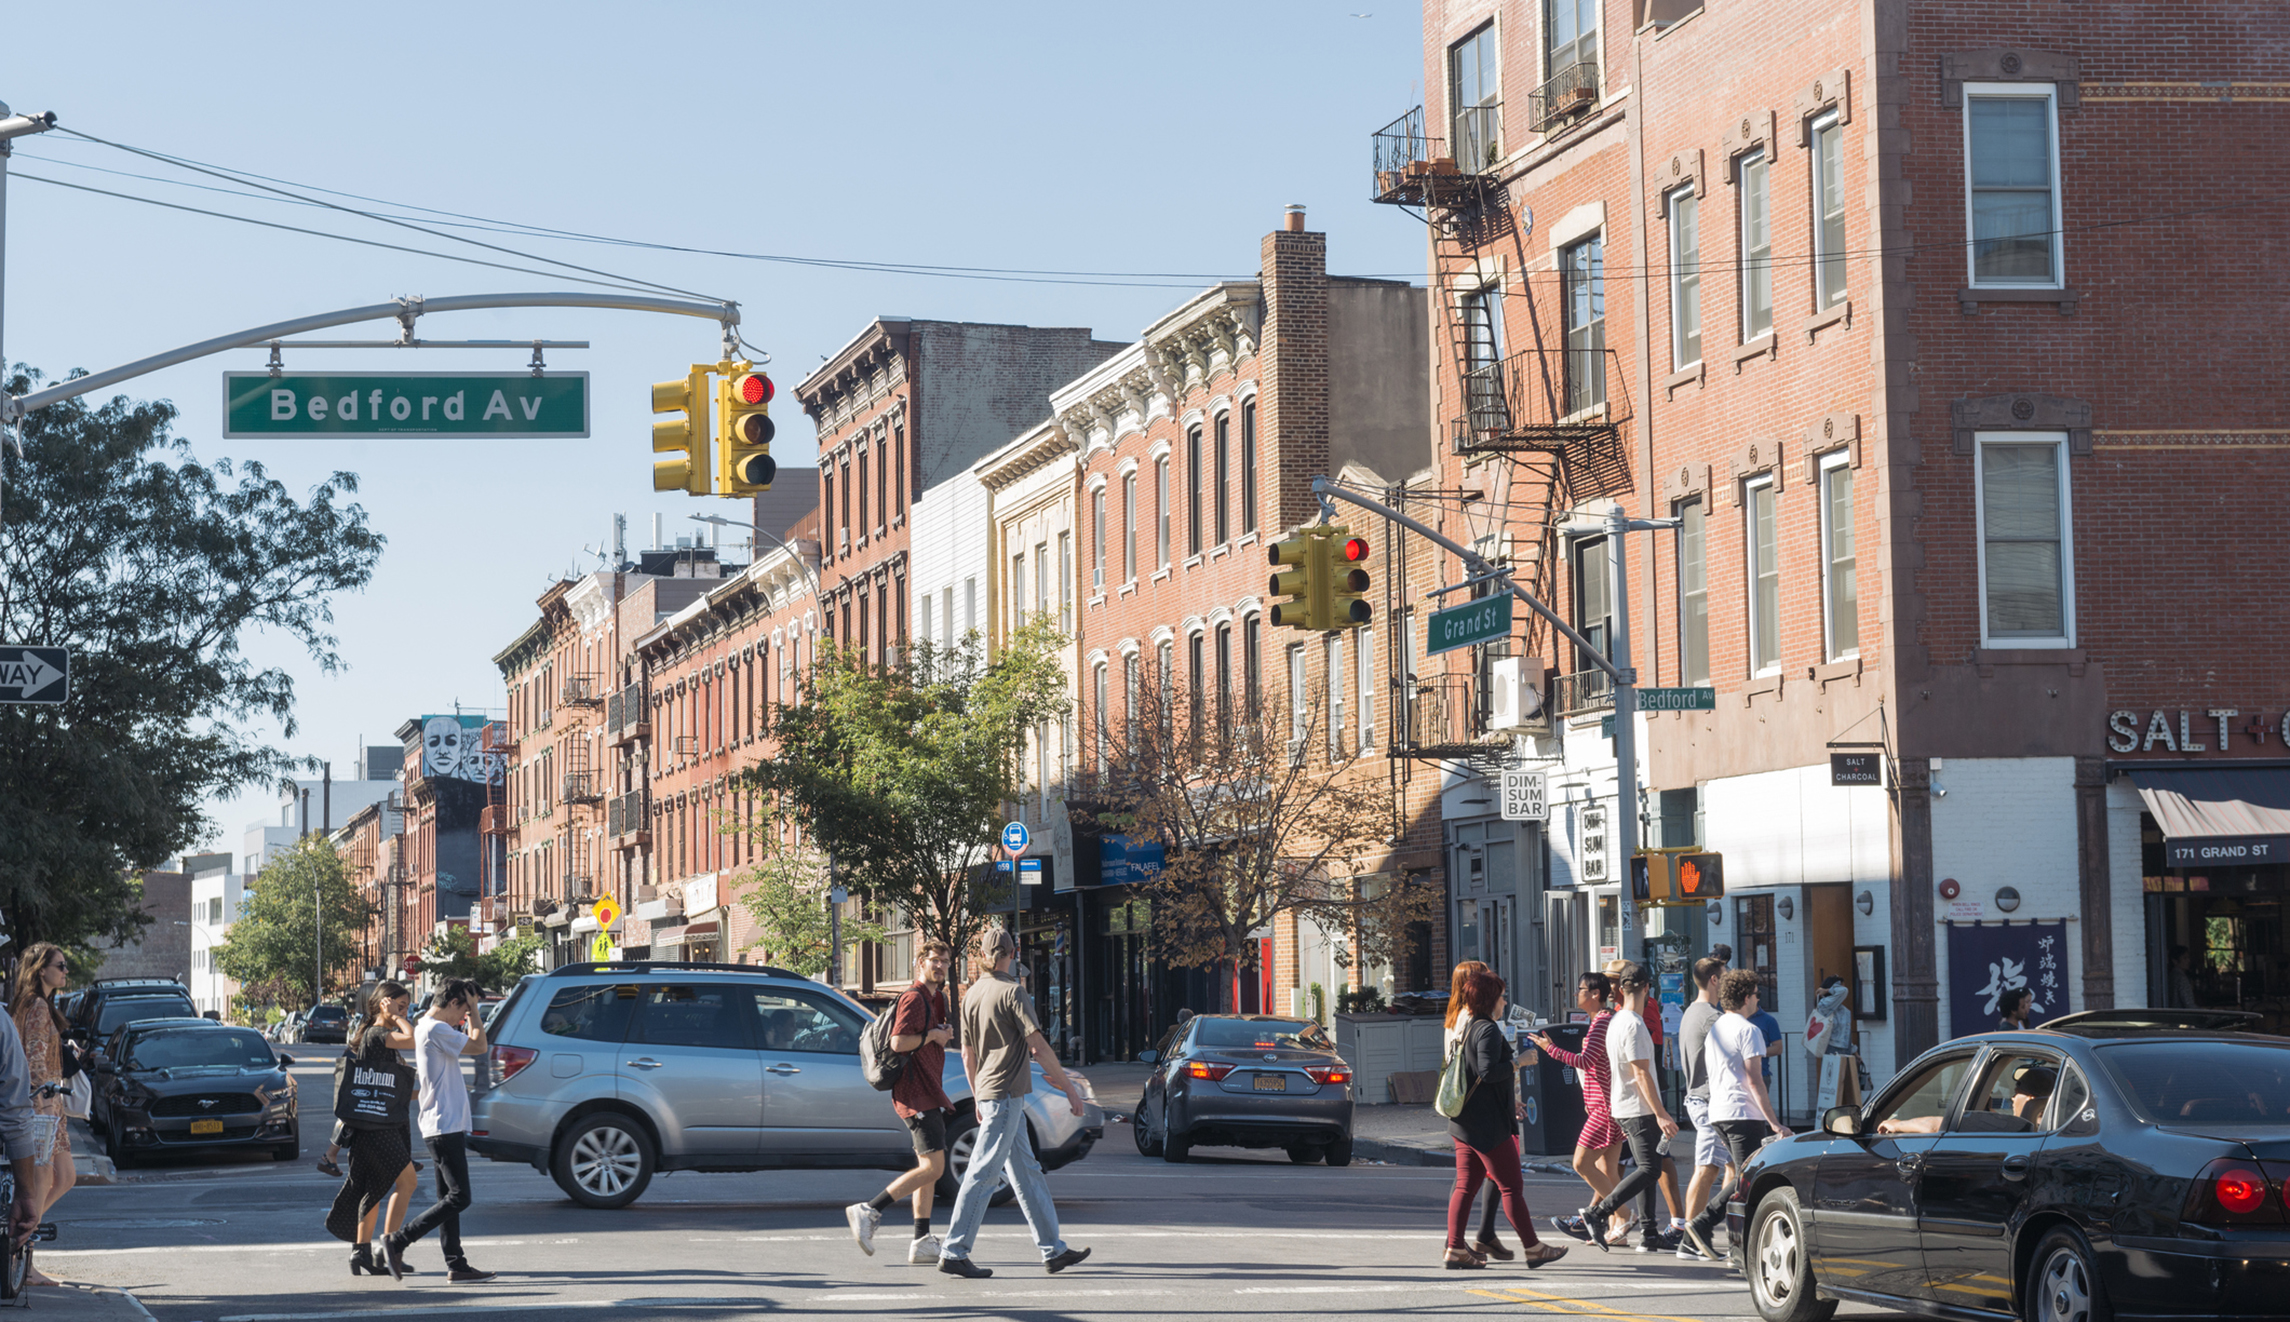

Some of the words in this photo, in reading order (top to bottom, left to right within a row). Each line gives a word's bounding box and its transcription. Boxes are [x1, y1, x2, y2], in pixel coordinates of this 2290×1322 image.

[270, 389, 466, 422] Bedford
[482, 390, 543, 421] Av
[1444, 611, 1481, 640] Grand
[1483, 607, 1497, 630] St
[1639, 690, 1697, 709] Bedford
[1702, 690, 1714, 700] Av
[2107, 709, 2239, 753] SALT
[1846, 758, 1865, 766] SALT
[1508, 776, 1542, 788] DIM-
[1835, 773, 1877, 781] CHARCOAL
[1508, 789, 1542, 801] SUM
[1508, 802, 1542, 815] BAR
[1584, 835, 1603, 854] SUM
[2174, 848, 2195, 859] 171
[2200, 845, 2247, 858] GRAND
[2251, 844, 2269, 856] ST
[1130, 861, 1161, 872] FALAFEL
[1585, 859, 1604, 877] BAR
[1784, 931, 1795, 944] 171
[353, 1066, 396, 1089] Holman
